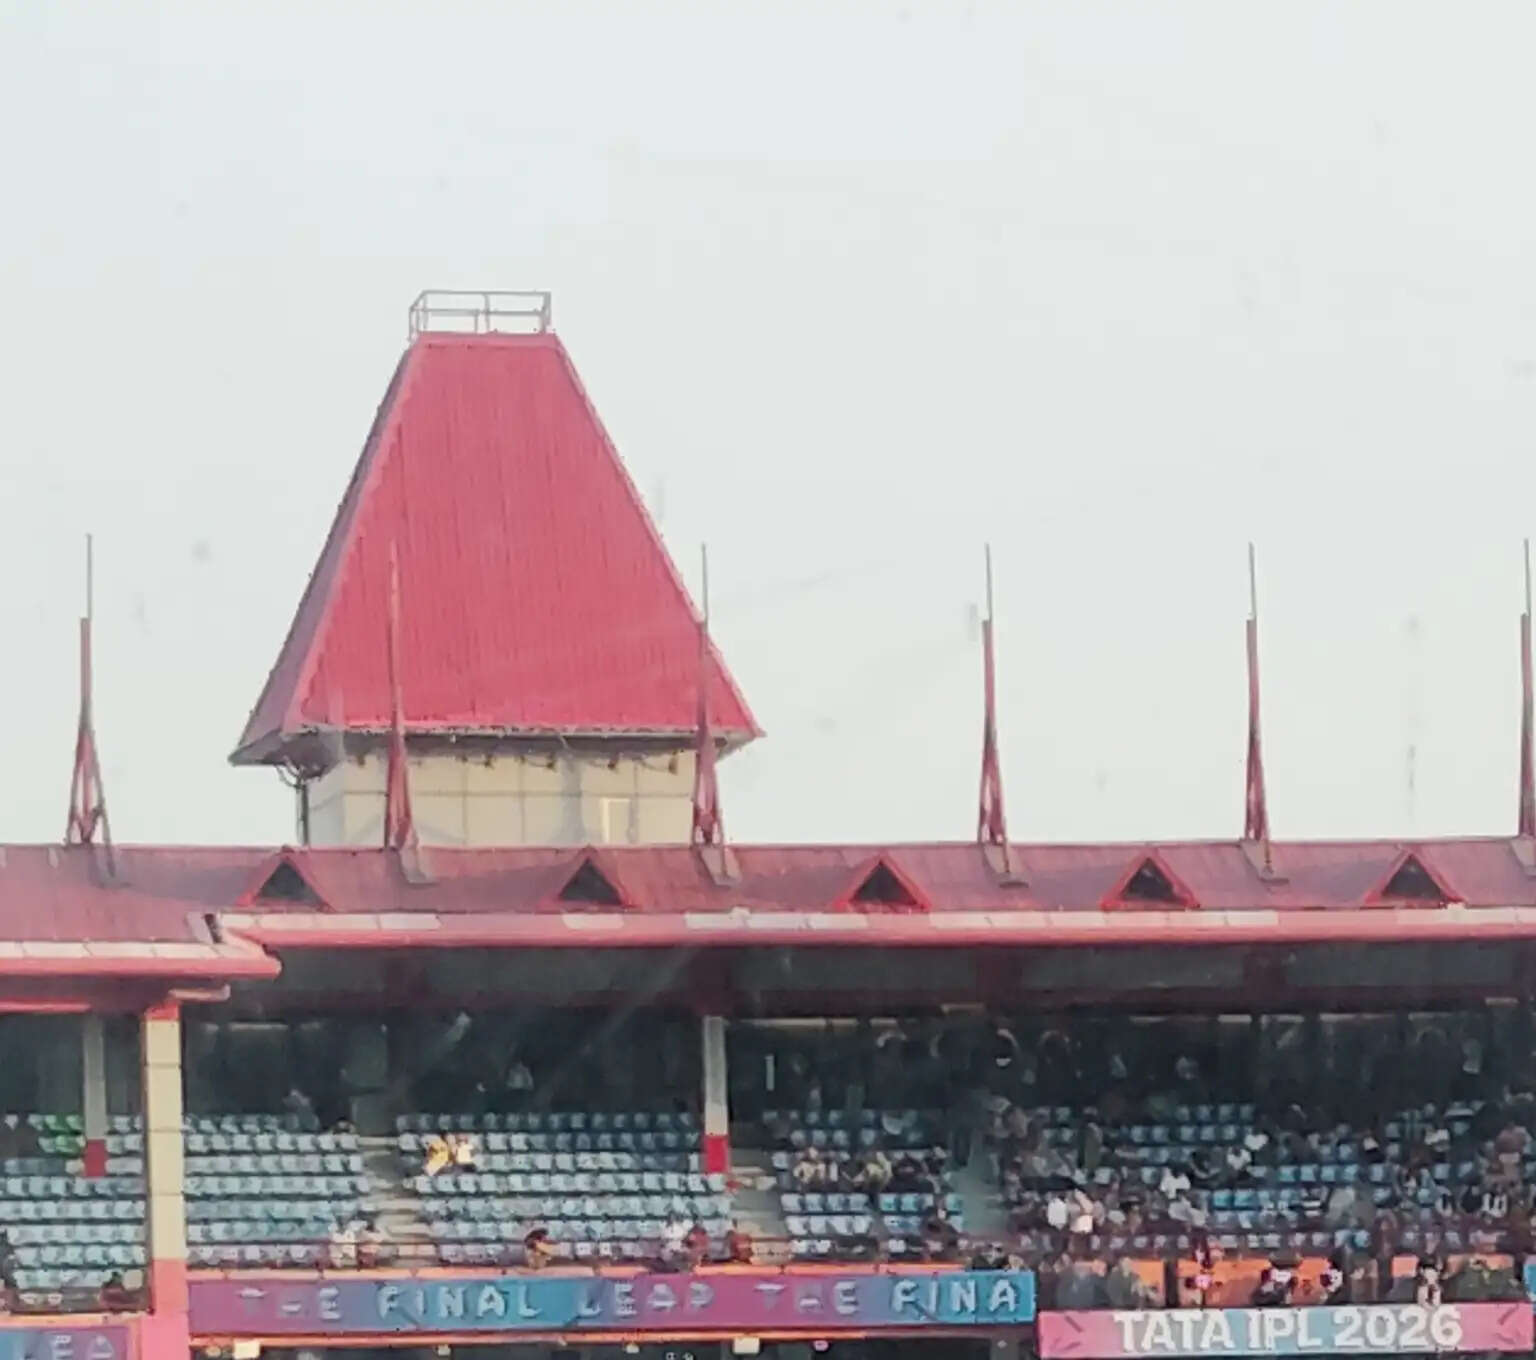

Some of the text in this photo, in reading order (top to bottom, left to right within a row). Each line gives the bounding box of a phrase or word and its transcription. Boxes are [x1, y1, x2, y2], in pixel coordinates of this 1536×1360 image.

[378, 1284, 541, 1320] FINAL
[1113, 1303, 1463, 1351] TATA IPL 2026
